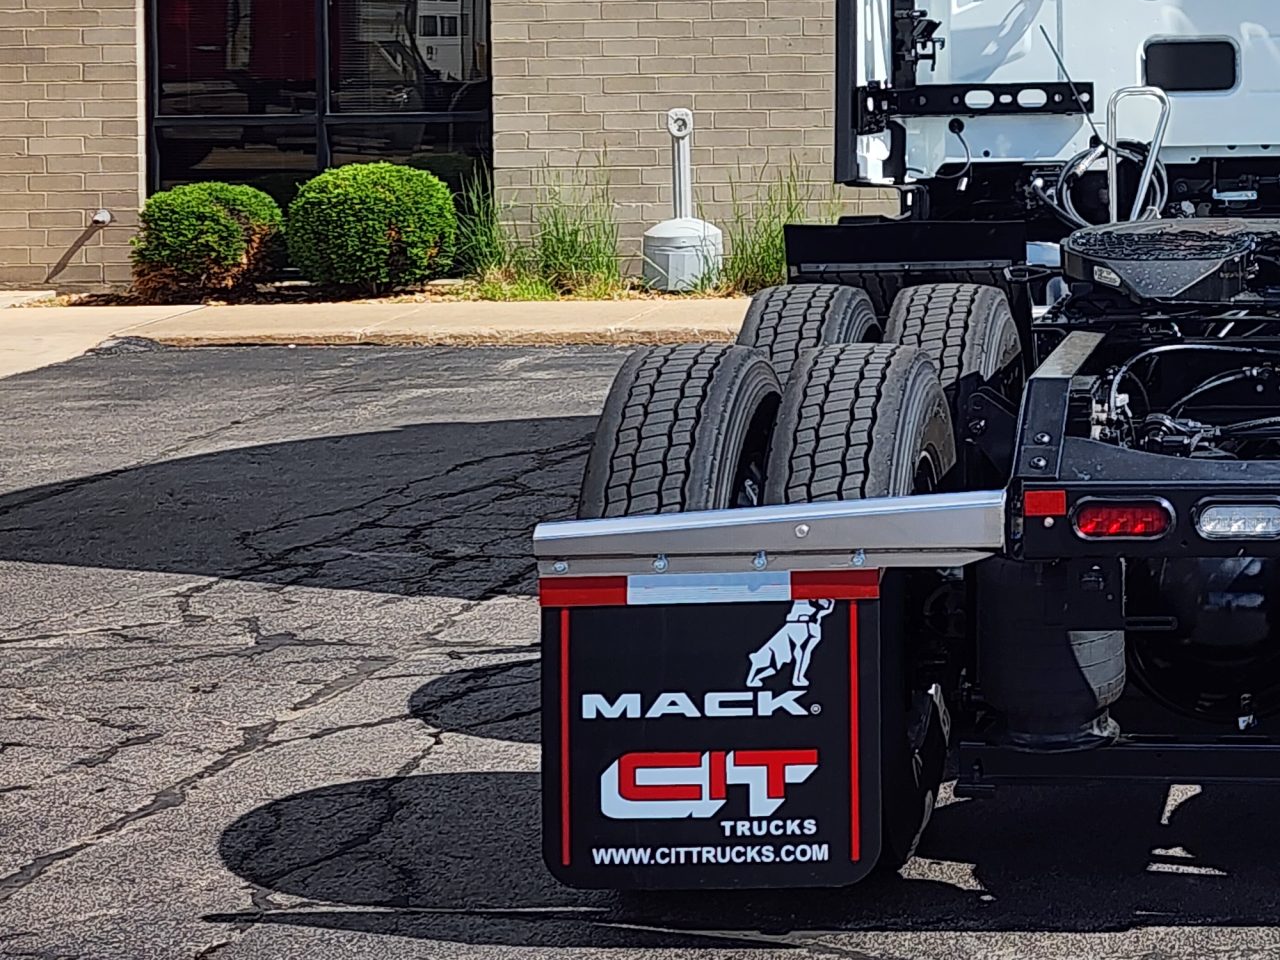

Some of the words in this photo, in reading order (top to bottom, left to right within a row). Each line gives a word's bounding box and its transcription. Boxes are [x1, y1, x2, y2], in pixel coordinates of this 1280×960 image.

[601, 749, 818, 819] CIT
[721, 819, 818, 836] TRUCKS
[592, 844, 829, 865] WWW.CITTRUCKS.COM
